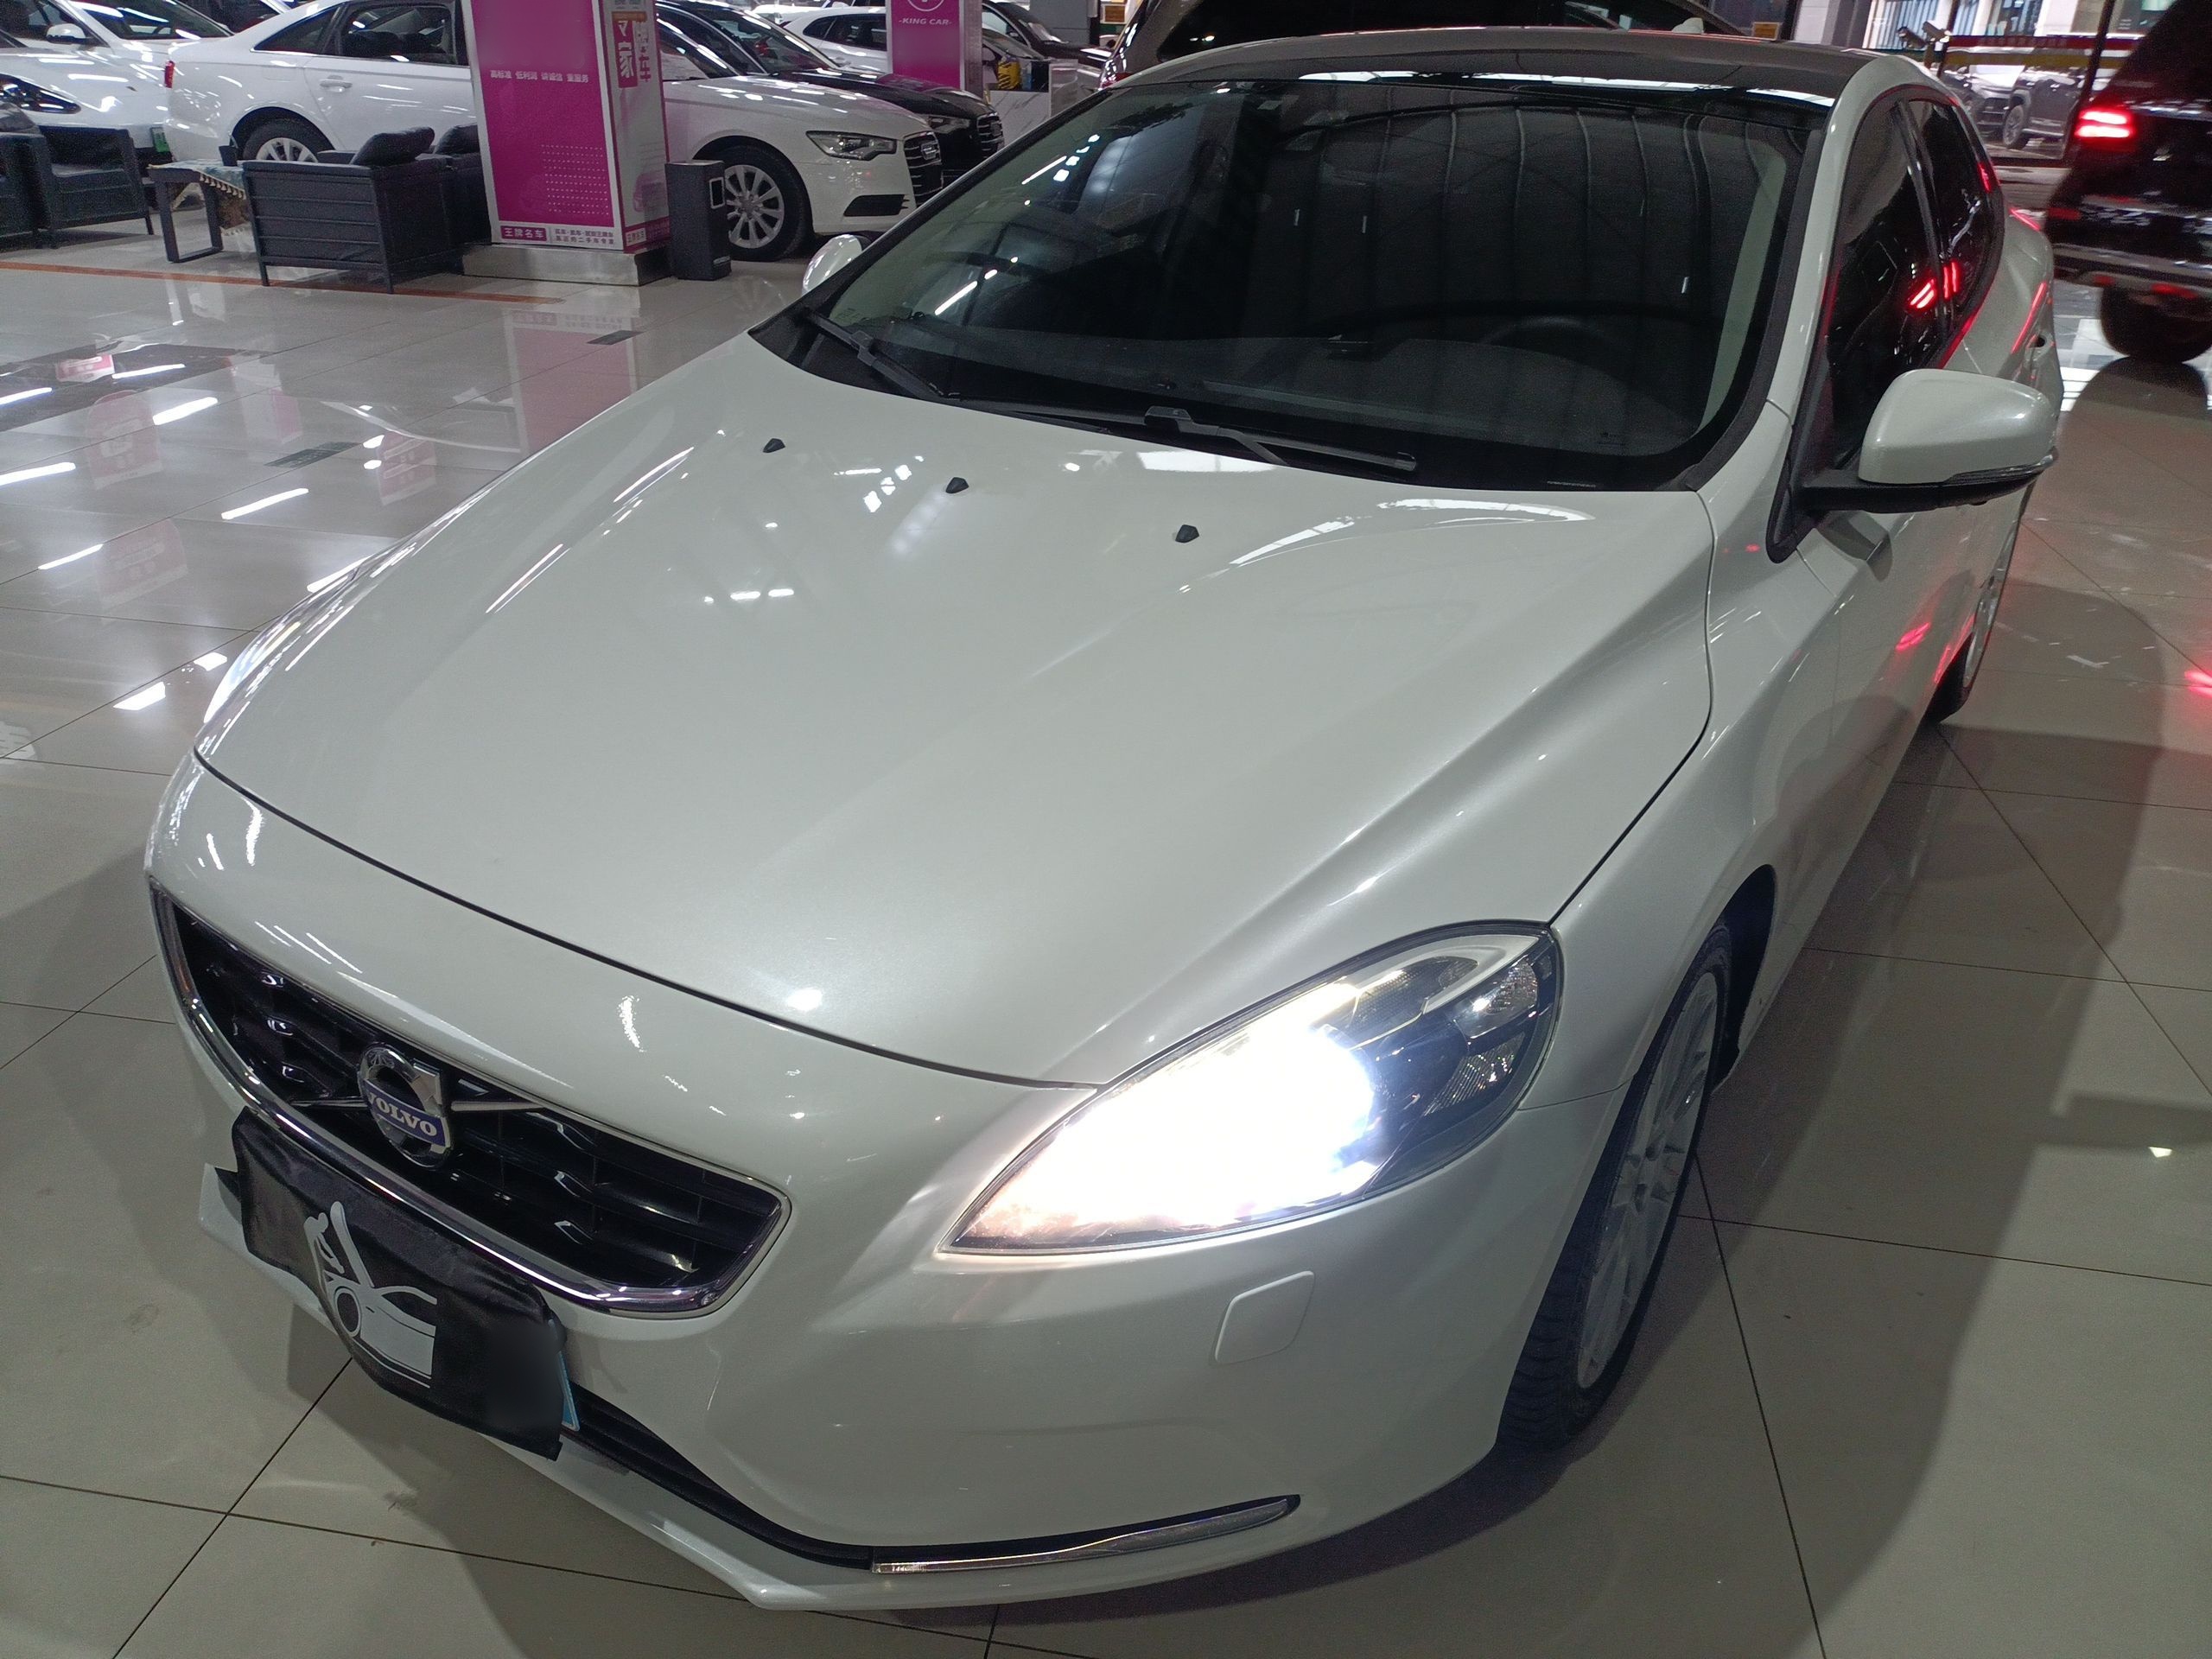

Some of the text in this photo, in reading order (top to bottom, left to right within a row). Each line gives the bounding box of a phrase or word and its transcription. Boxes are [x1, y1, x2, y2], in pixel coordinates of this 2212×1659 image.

[504, 227, 544, 239] 王牌名车
[368, 1091, 437, 1137] VOLVO
